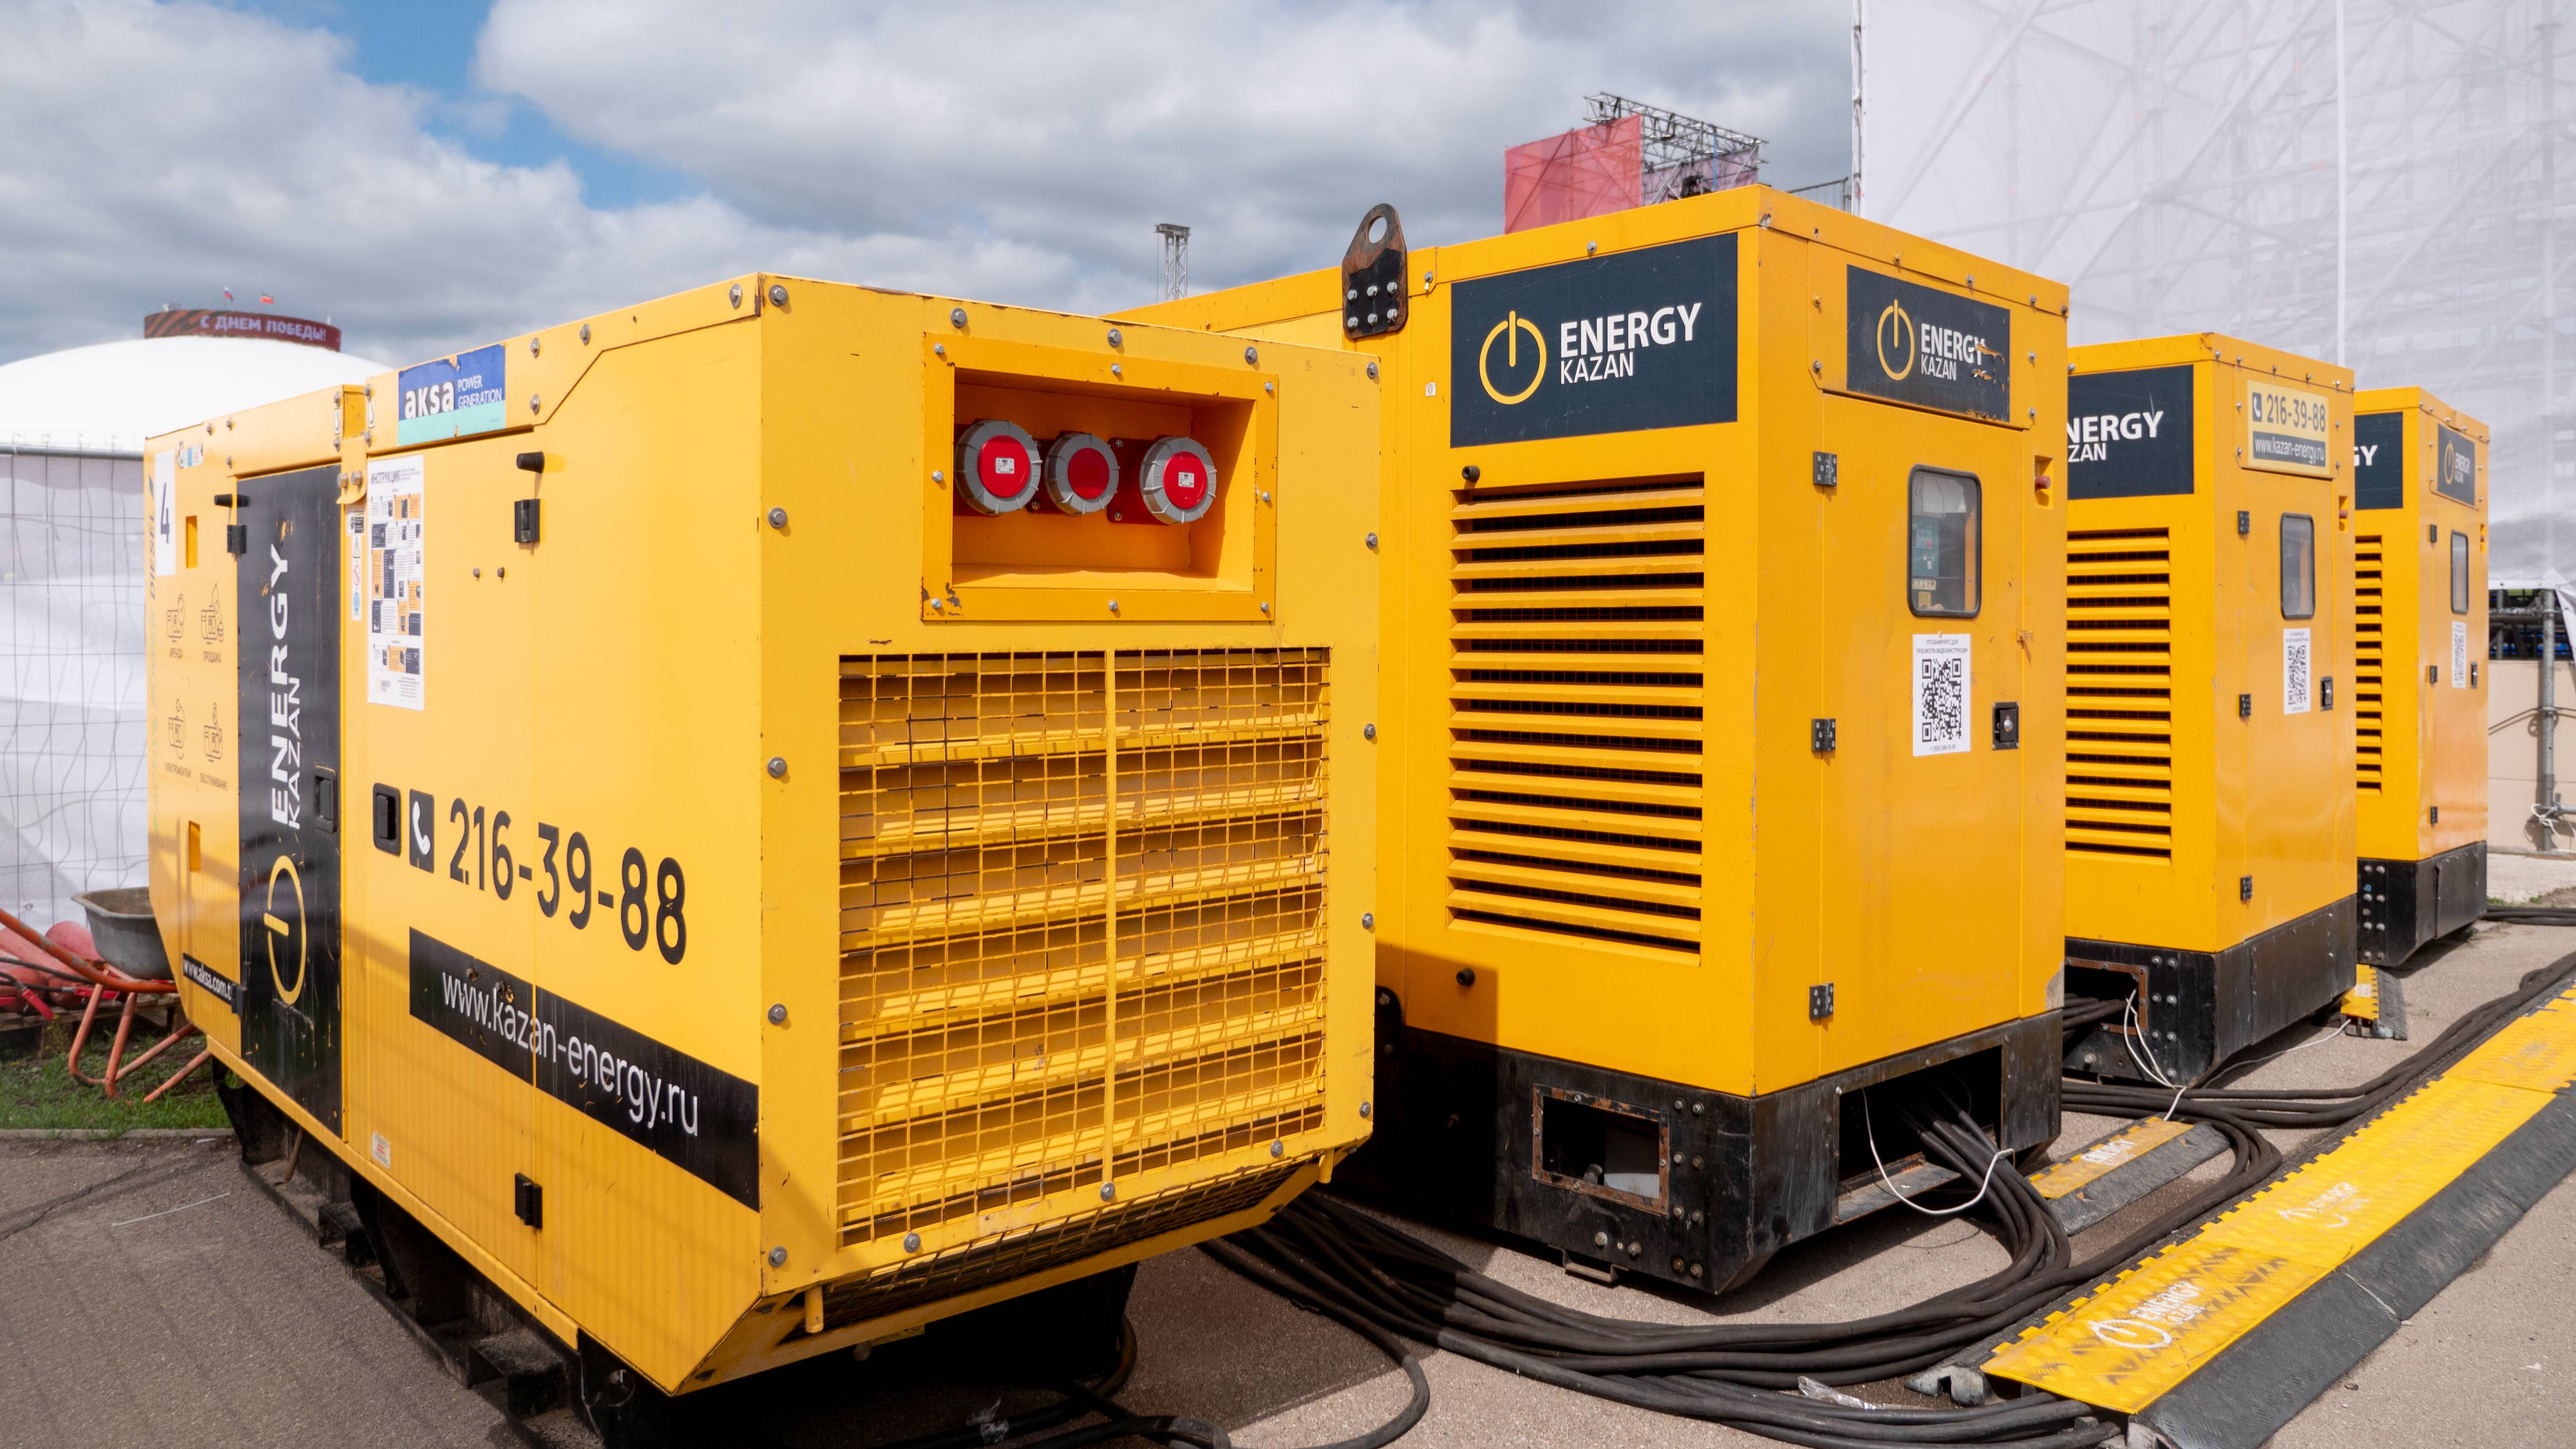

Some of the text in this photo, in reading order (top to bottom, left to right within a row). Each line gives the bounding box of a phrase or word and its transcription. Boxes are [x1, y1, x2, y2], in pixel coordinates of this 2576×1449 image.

[200, 315, 326, 341] С ДНЕМ ПОБЕДЫ!
[1560, 303, 1701, 358] ENERGY
[1921, 323, 1985, 365] ENERGY
[458, 375, 483, 393] POWER
[1560, 352, 1633, 384] KAZAN
[1921, 354, 1956, 381] KAZAN
[404, 382, 455, 419] aksa
[458, 388, 502, 409] GENERATION
[2266, 393, 2326, 433] 216-39-88
[2254, 436, 2325, 464] www.kazan-energy.ru
[161, 483, 170, 544] 4
[271, 543, 288, 825] ENERGY
[288, 677, 300, 829] KAZAN
[450, 797, 687, 965] 216-39-88
[183, 959, 233, 1001] www.aksa.com.t
[442, 971, 698, 1136] www.kazan-energy.ru
